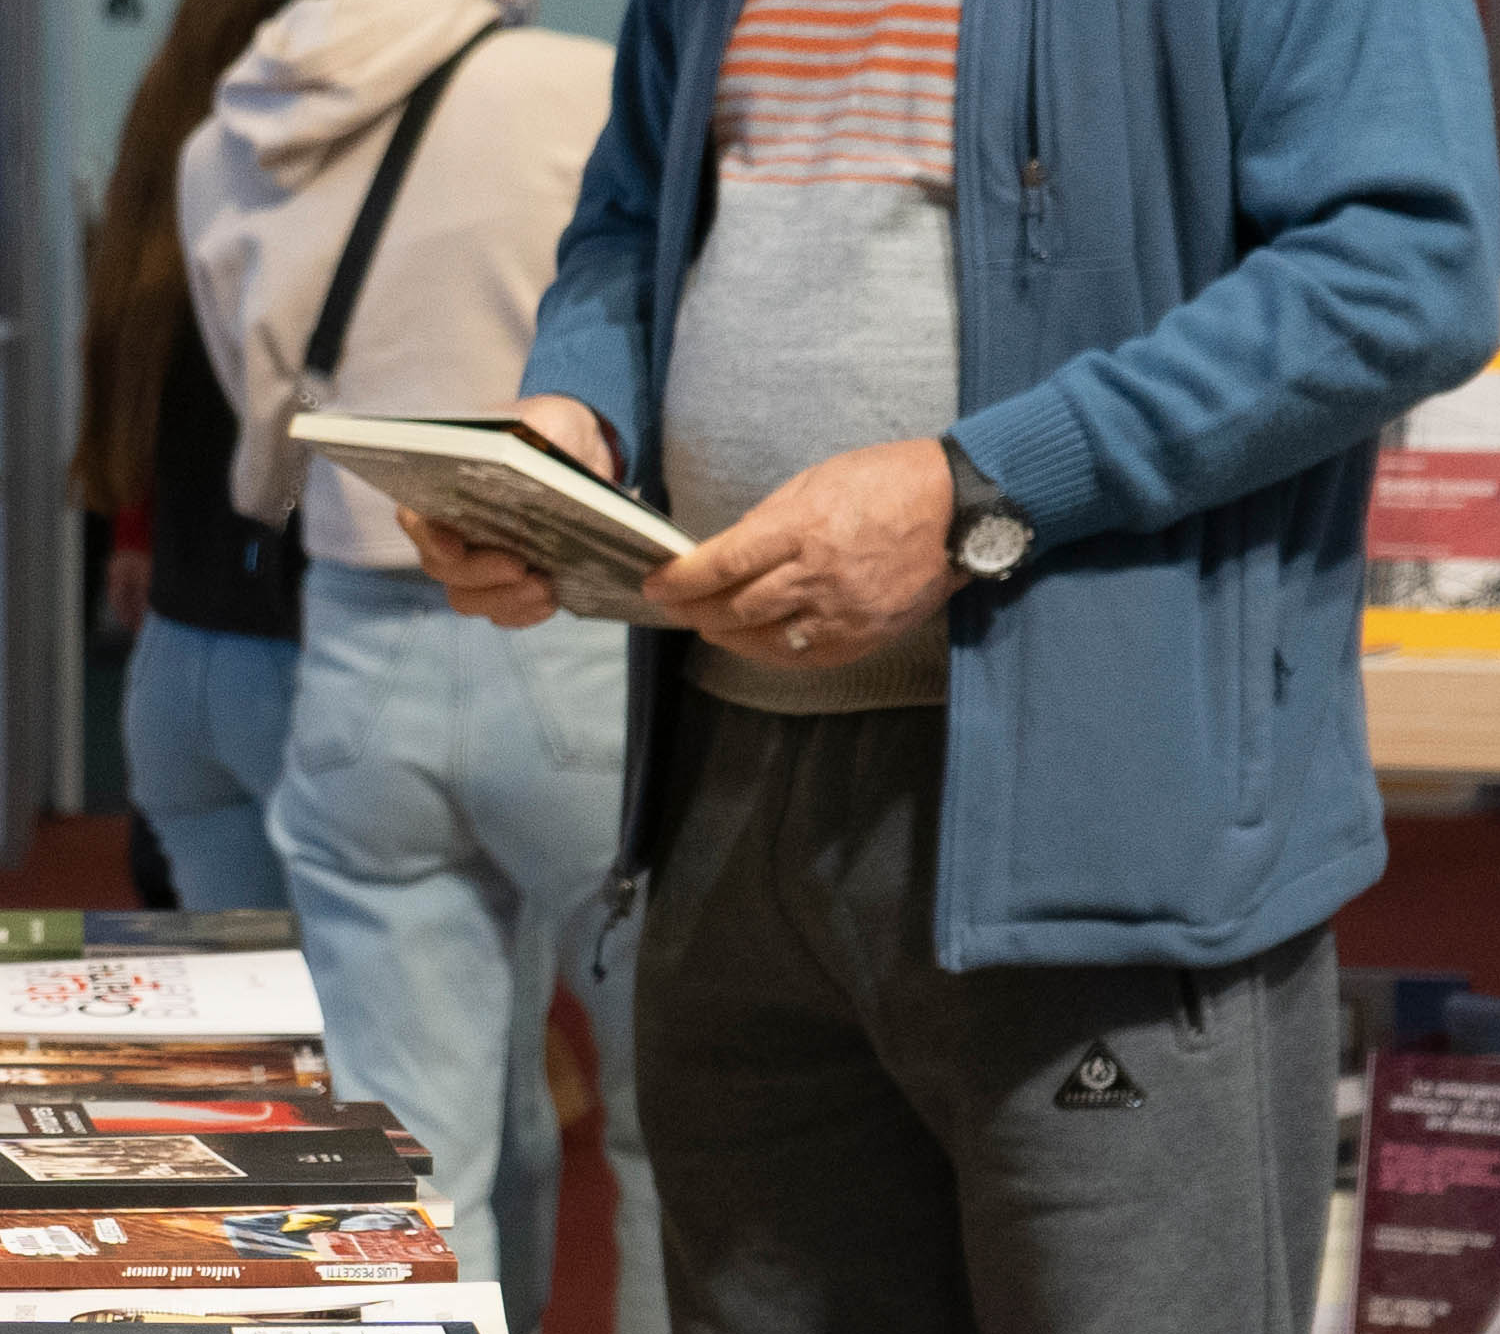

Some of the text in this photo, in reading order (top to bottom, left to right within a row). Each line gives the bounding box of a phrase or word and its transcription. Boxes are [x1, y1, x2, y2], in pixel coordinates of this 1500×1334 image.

[121, 1265, 246, 1281] Anita, mi amor
[325, 1267, 400, 1279] LUIS PESCETTI
